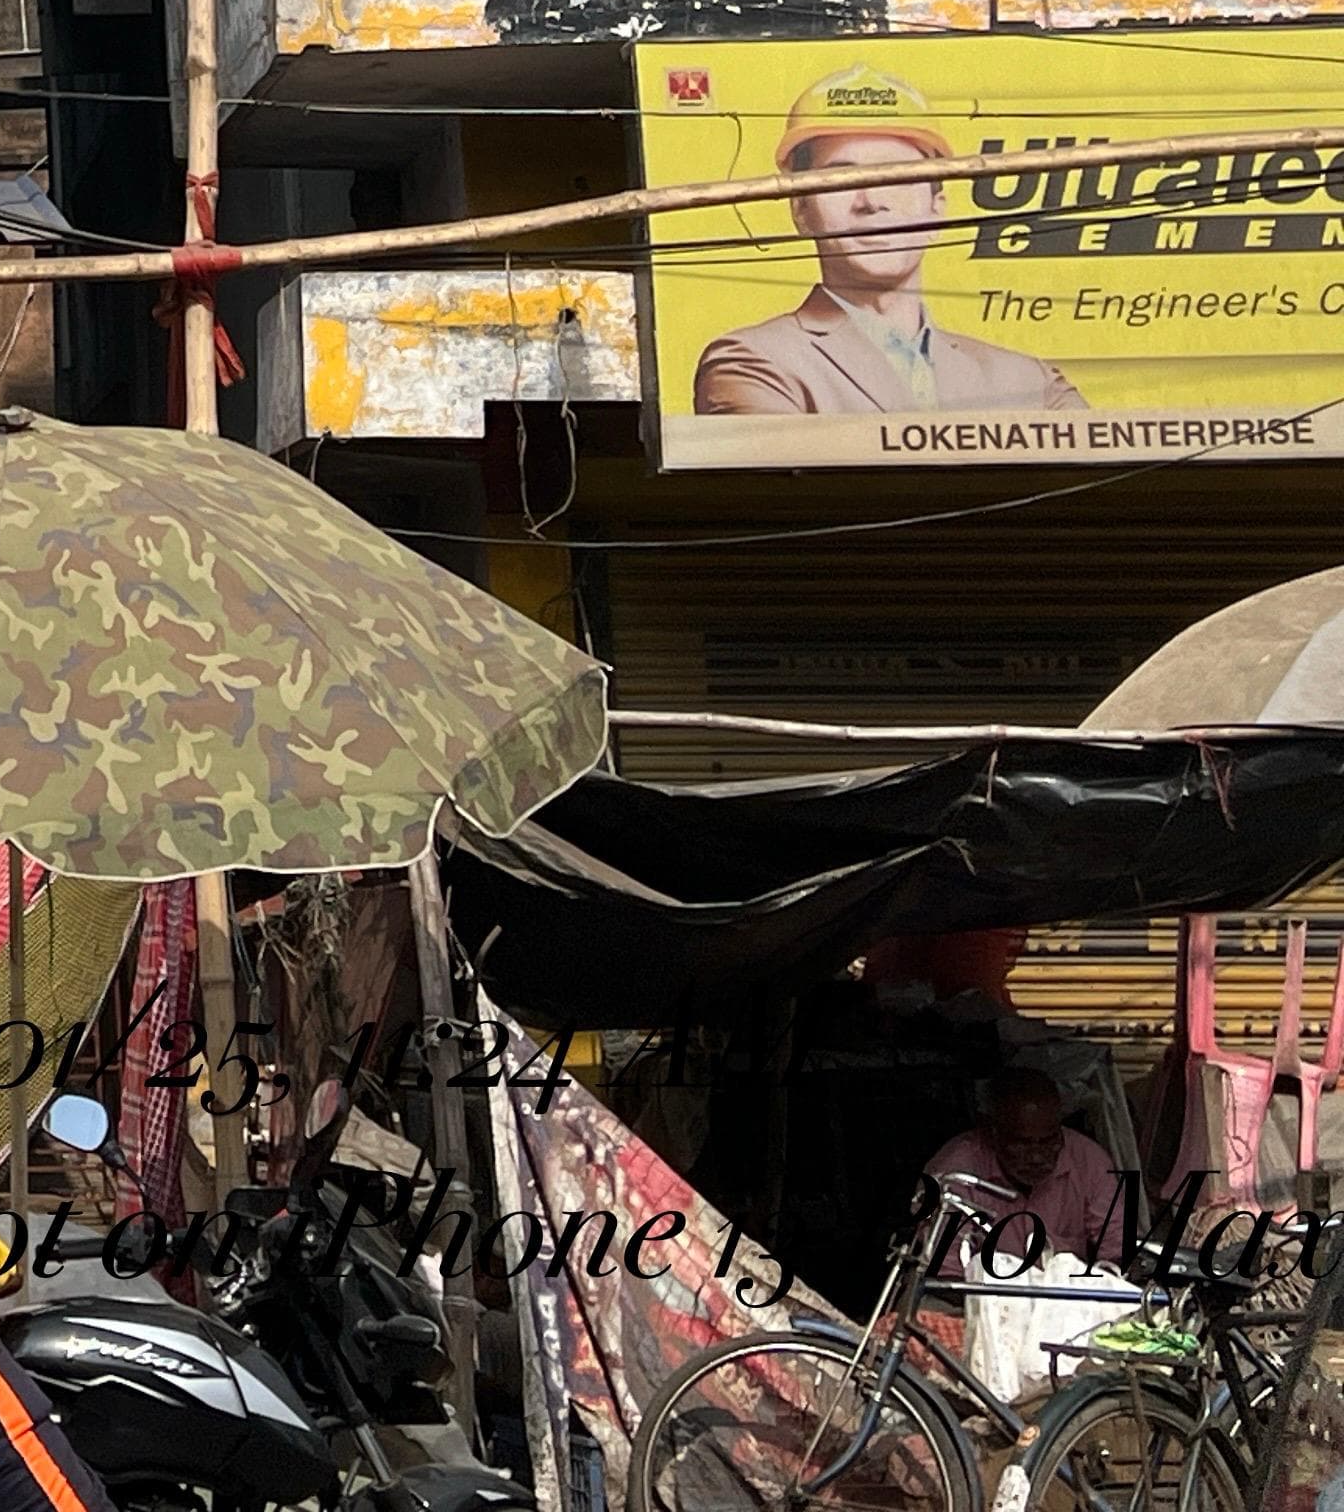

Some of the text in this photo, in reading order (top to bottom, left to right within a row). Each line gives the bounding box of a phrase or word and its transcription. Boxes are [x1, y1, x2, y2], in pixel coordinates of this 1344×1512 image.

[979, 289, 1053, 322] The
[1073, 284, 1299, 327] Engineer's
[880, 415, 1315, 452] LOKENATH ENTERPRISE
